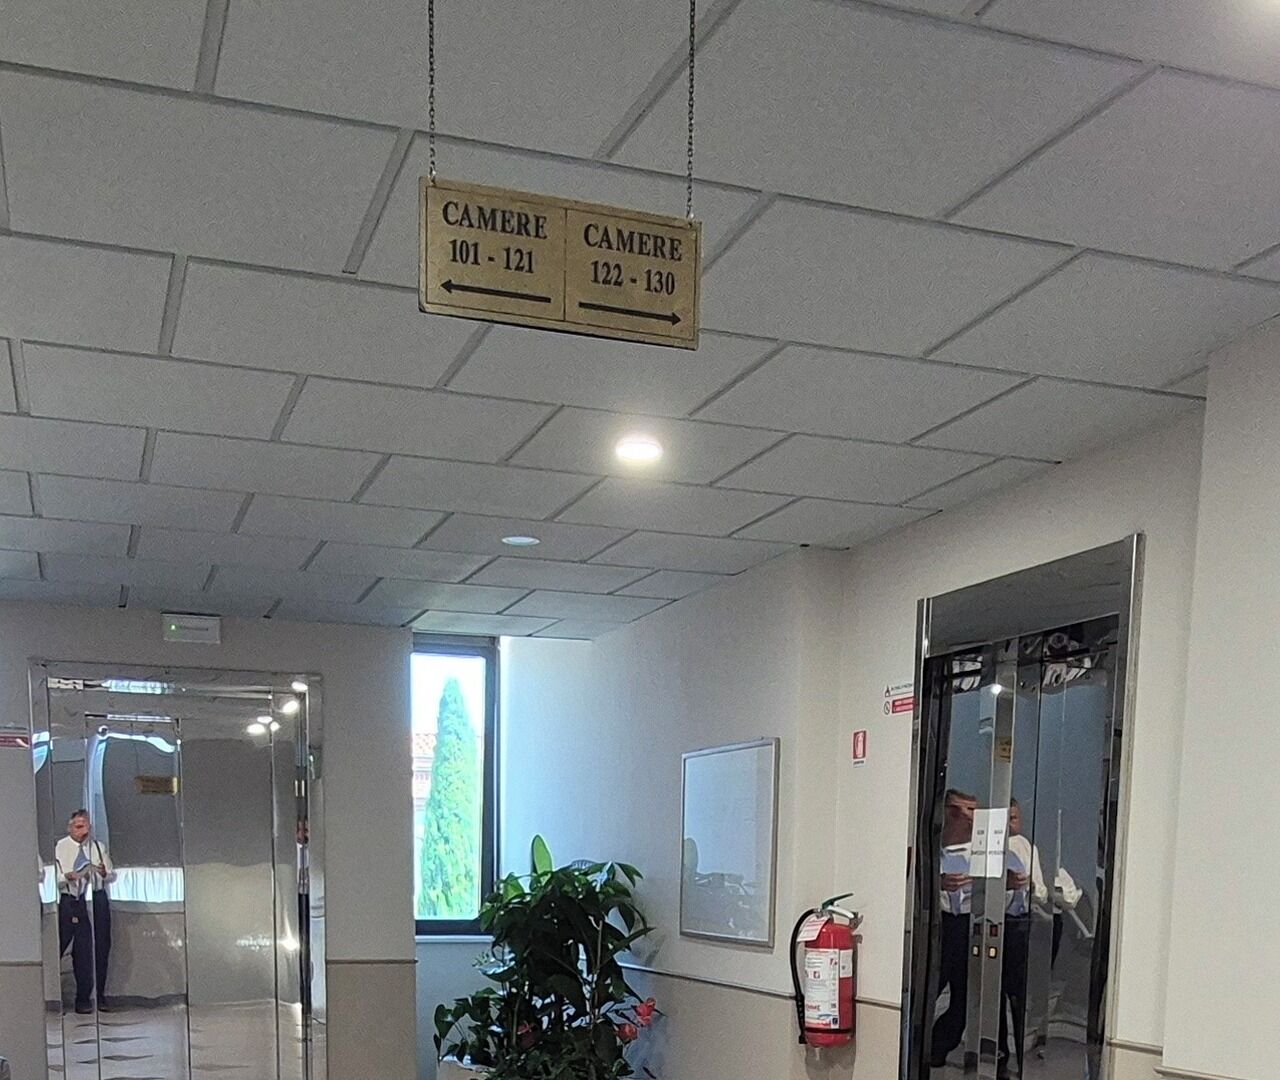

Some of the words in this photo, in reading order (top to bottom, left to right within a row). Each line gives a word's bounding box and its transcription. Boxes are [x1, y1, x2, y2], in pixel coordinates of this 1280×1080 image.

[442, 200, 548, 240] CAMERE
[449, 239, 480, 266] 101
[503, 246, 535, 274] 121
[583, 223, 683, 262] CAMERE
[591, 260, 624, 288] 122
[644, 269, 675, 296] 130
